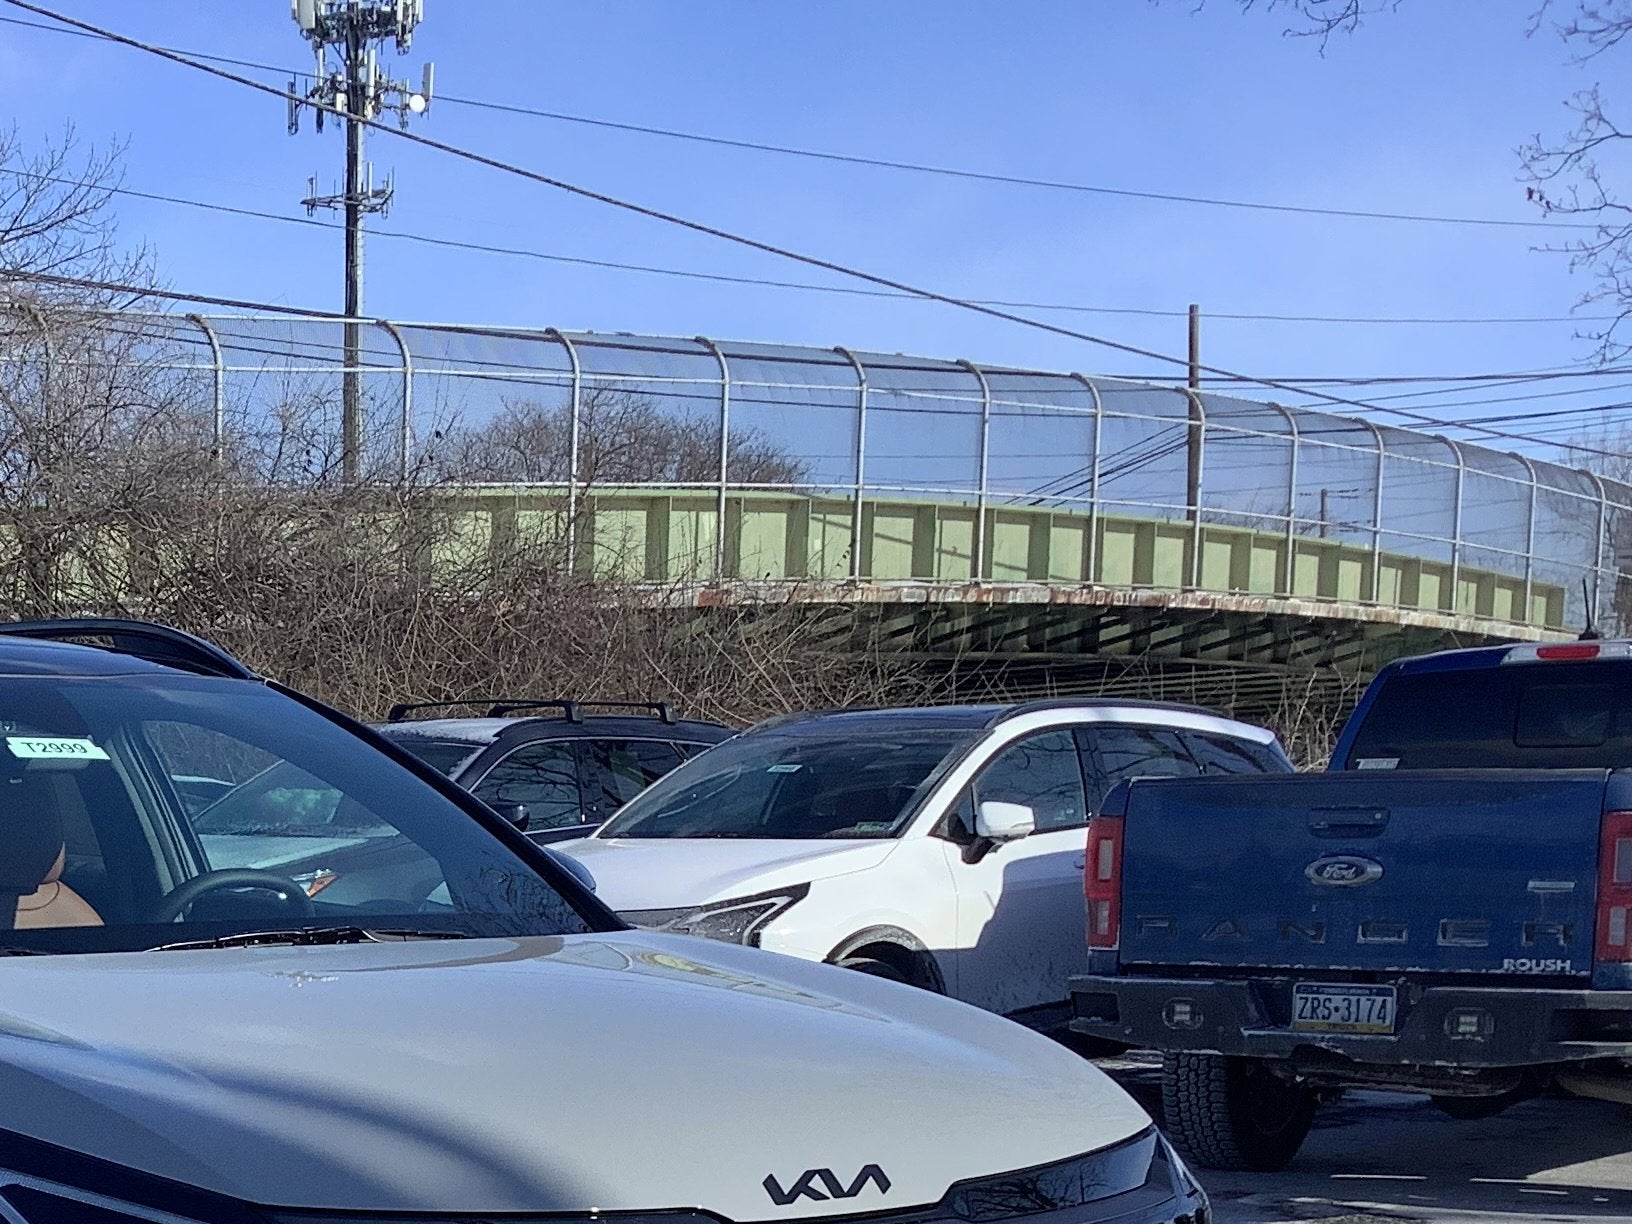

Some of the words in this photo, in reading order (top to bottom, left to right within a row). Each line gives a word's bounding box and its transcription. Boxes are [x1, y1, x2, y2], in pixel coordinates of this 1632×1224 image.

[21, 742, 88, 754] T2999
[1322, 863, 1356, 880] Ford
[1136, 914, 1574, 947] RANGER
[1503, 958, 1571, 971] ROUSH
[762, 1164, 892, 1205] KIA
